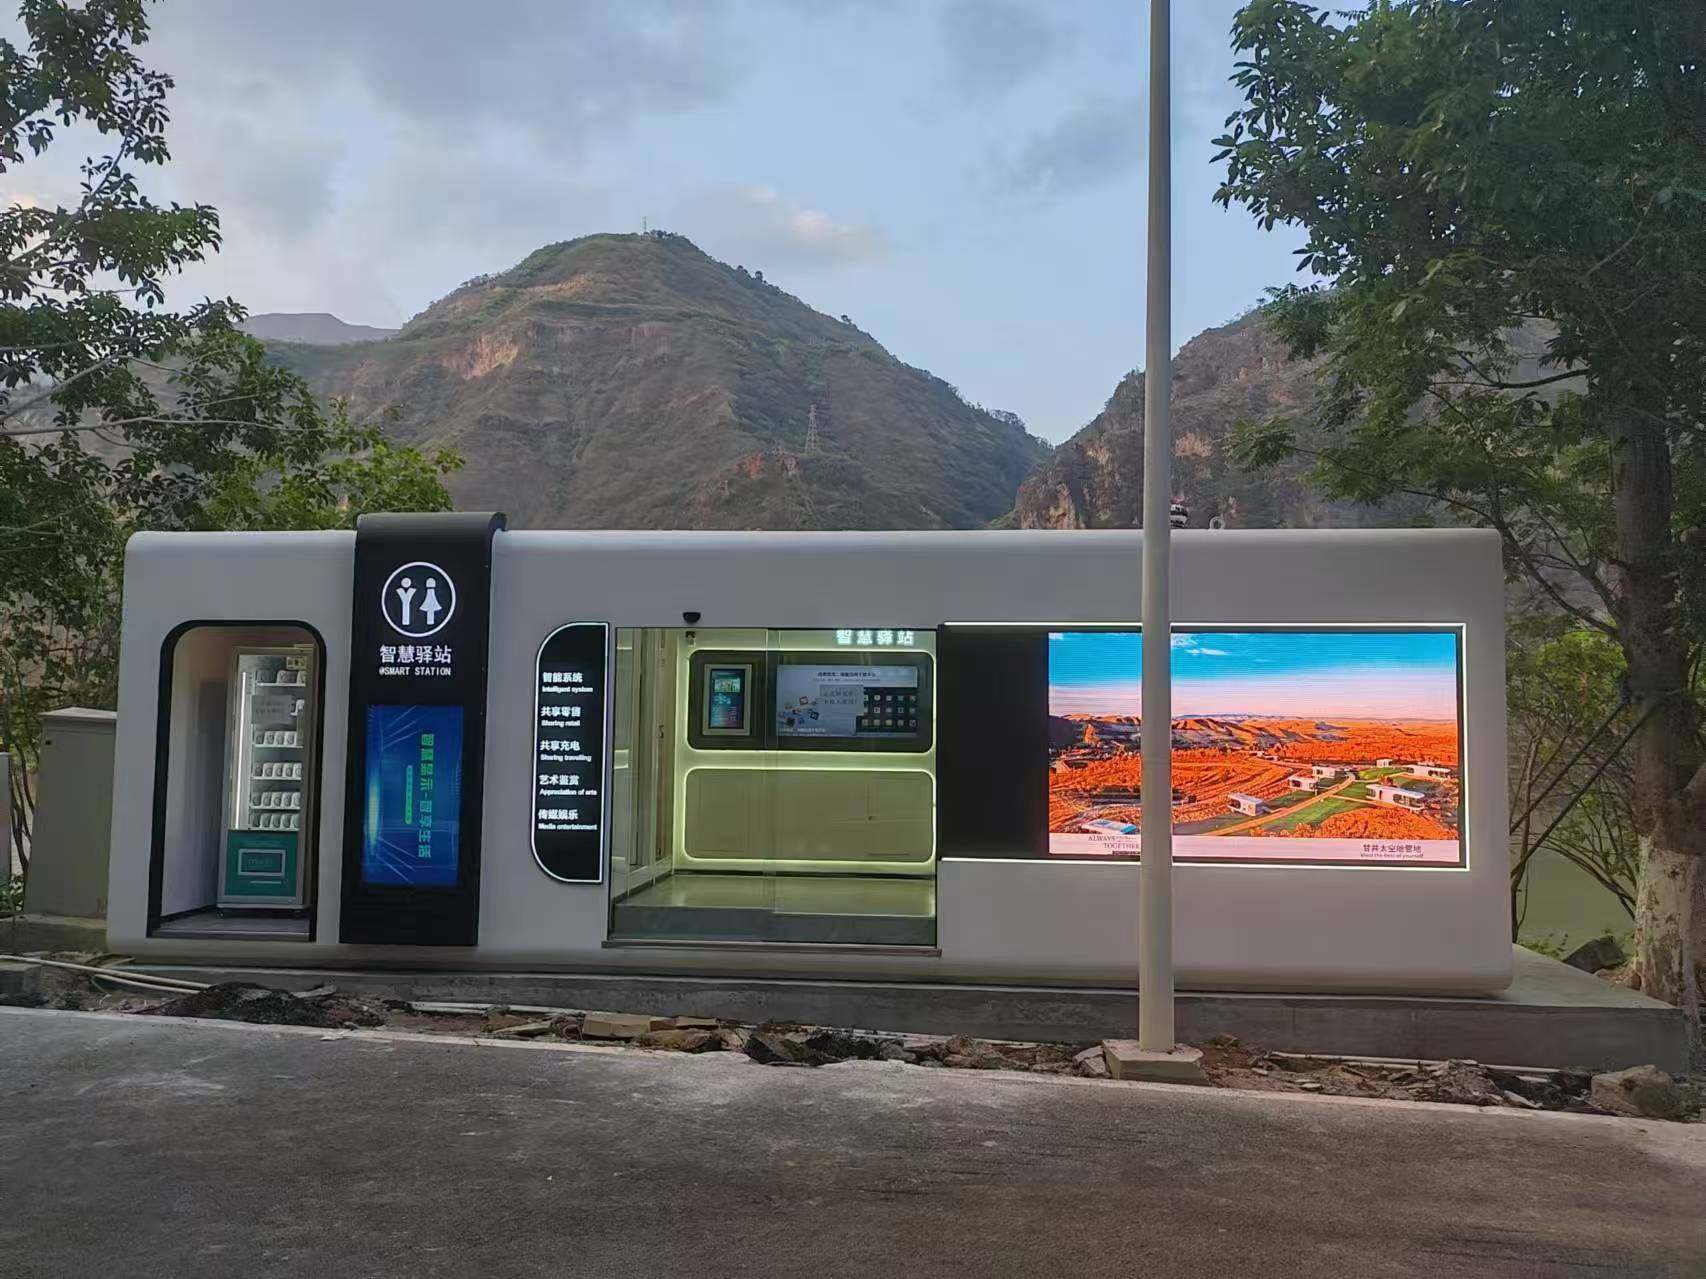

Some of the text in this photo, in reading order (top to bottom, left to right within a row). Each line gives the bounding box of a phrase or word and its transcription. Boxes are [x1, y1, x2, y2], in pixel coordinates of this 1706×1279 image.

[836, 629, 914, 646] 智慧驿站
[379, 644, 452, 664] 智慧驿站
[414, 666, 451, 676] STATION
[542, 672, 583, 683] 智能系统
[540, 706, 581, 717] 共享零售
[541, 720, 565, 728] Sharing
[540, 740, 580, 751] 共享充电
[541, 754, 563, 762] Sharing
[539, 774, 580, 786] 艺术鉴赏
[540, 788, 577, 796] Appreciation
[578, 788, 585, 796] of
[538, 809, 579, 820] 传媒娱乐
